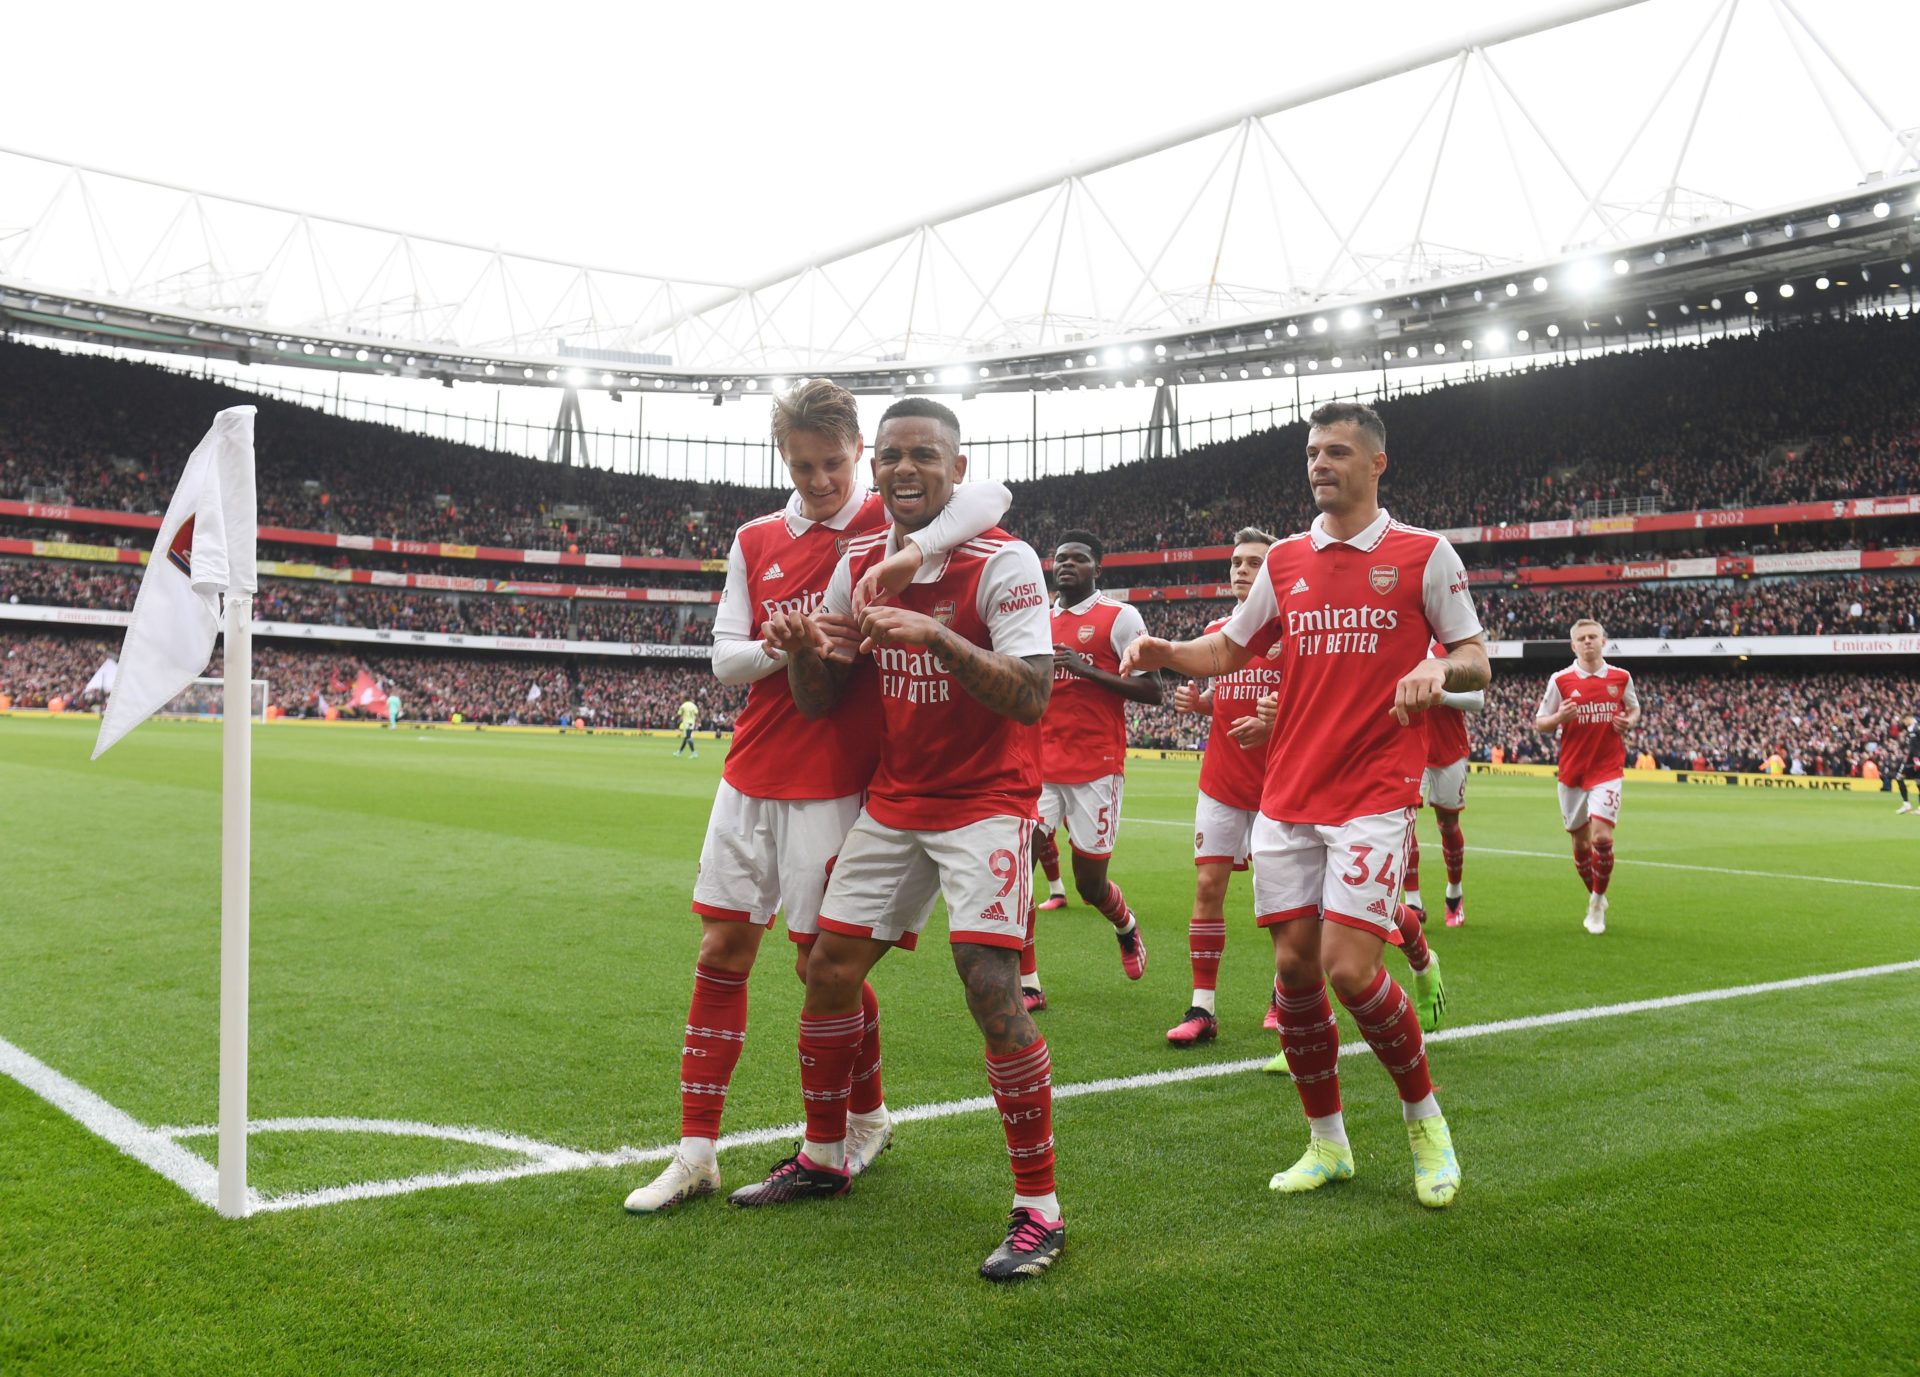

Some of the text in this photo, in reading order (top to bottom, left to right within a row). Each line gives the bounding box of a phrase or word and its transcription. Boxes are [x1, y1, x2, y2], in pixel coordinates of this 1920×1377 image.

[1711, 510, 1745, 526] 2002
[1499, 526, 1528, 539] 2002
[763, 571, 784, 582] adidas
[1622, 563, 1664, 579] Arsenal
[575, 586, 627, 599] Arsenal.com
[1008, 582, 1037, 598] VISIT
[761, 589, 823, 621] Emir
[1287, 603, 1398, 637] Emirates
[1299, 632, 1379, 657] FLY BETTER
[1833, 639, 1893, 652] Emirates
[882, 675, 906, 699] FLY
[1219, 685, 1231, 700] FLY
[1808, 780, 1851, 791] HATE
[1603, 789, 1620, 811] 35
[1097, 806, 1109, 836] 5
[988, 848, 1018, 898] 9
[1342, 845, 1396, 898] 34
[980, 912, 1009, 923] adidas
[1366, 905, 1389, 918] adidas
[1284, 1041, 1328, 1056] AFC
[1002, 1107, 1042, 1125] AFC
